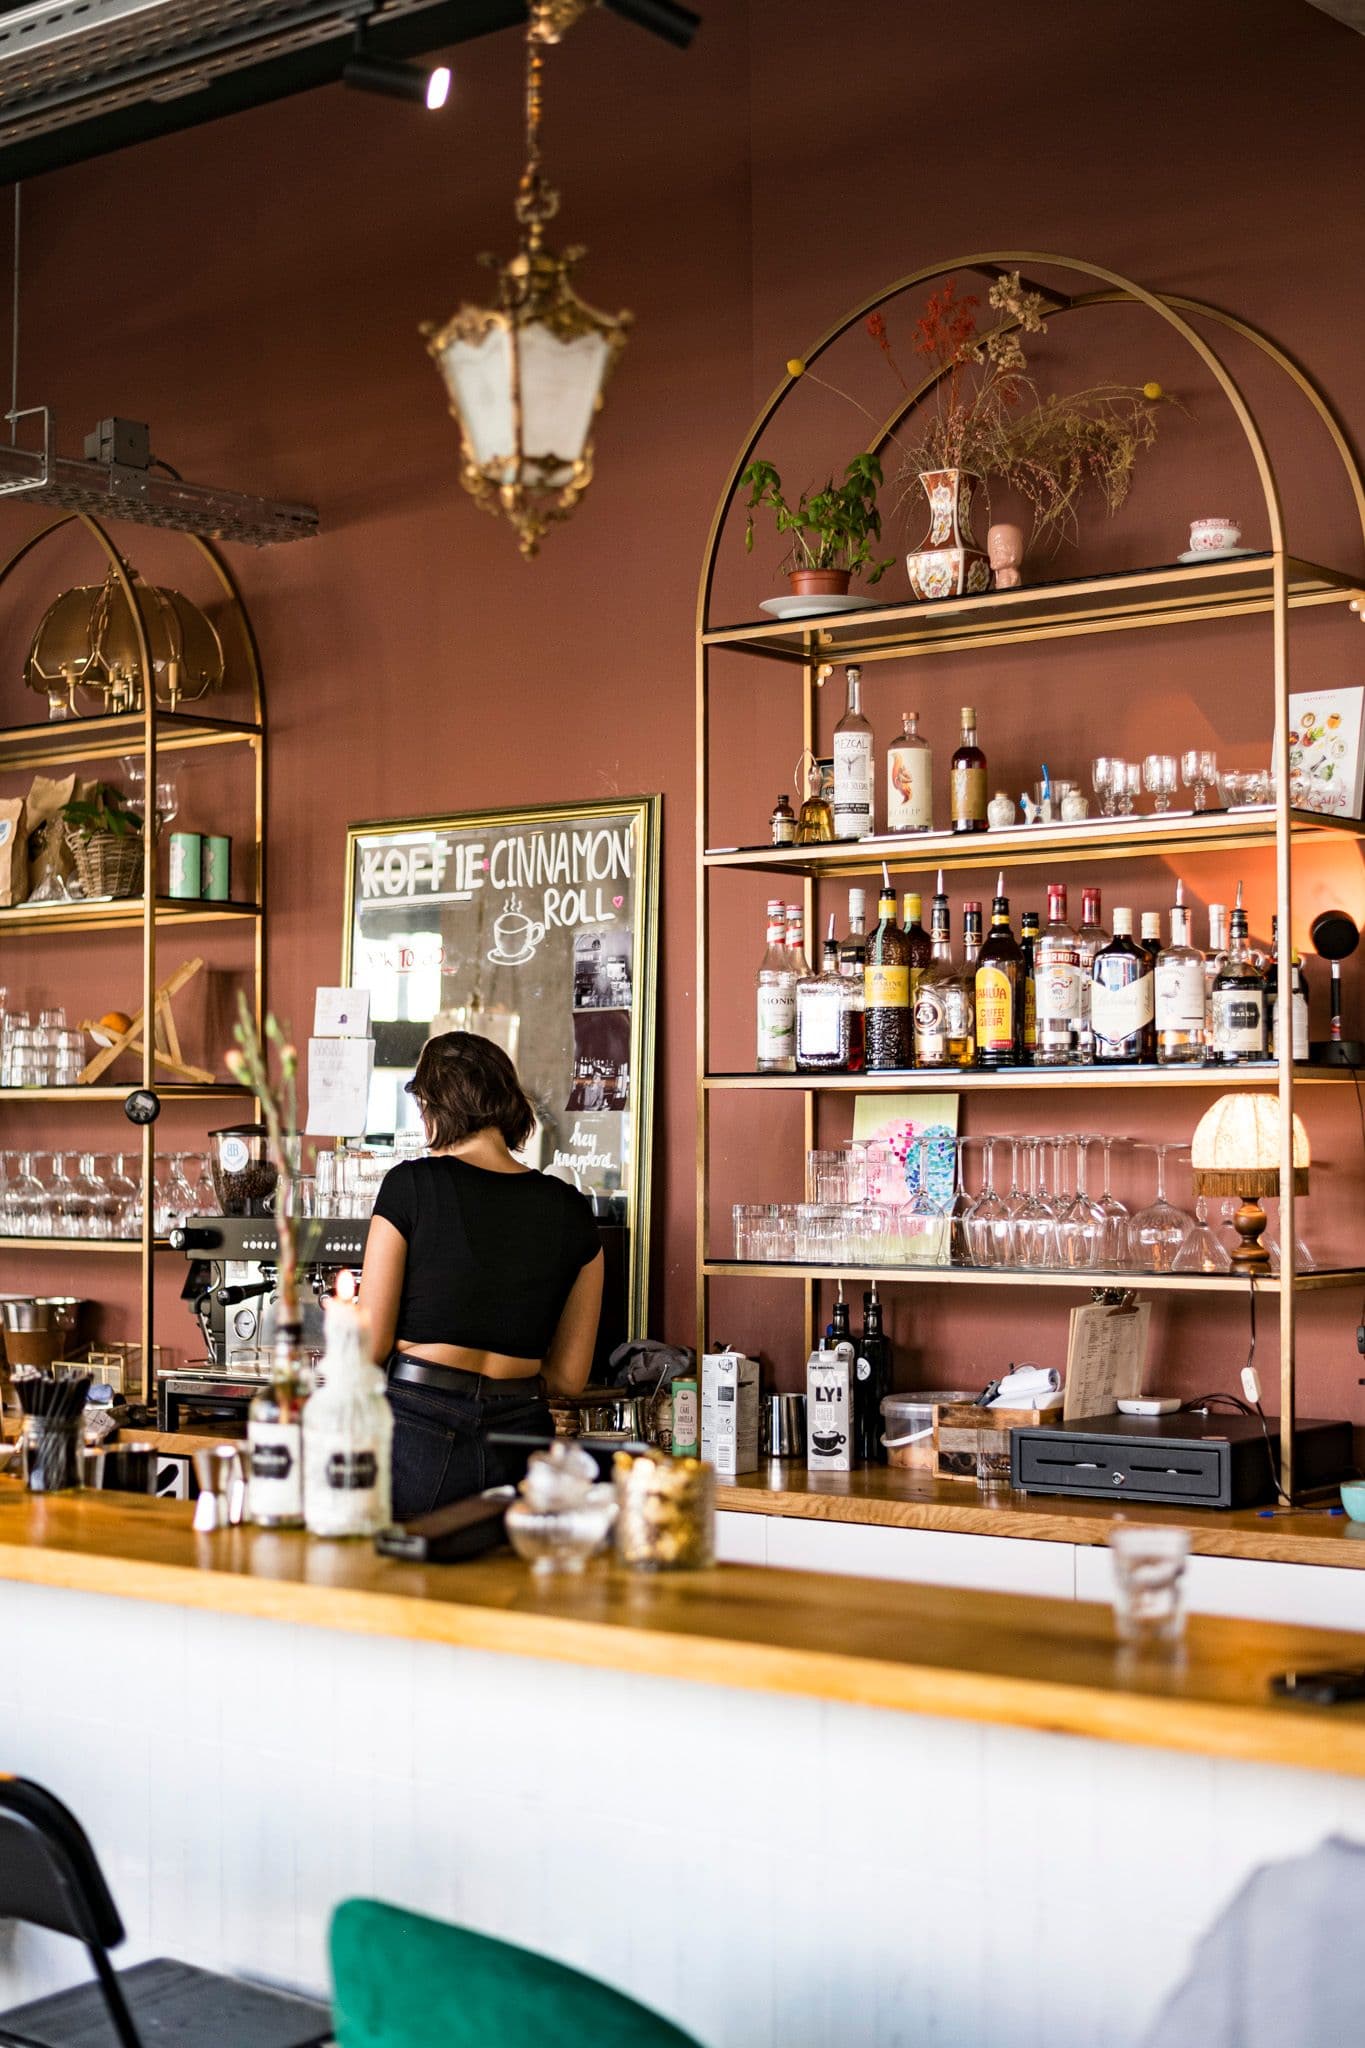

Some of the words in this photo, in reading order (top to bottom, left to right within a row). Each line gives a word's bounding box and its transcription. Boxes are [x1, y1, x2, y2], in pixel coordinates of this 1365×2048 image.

[361, 844, 484, 898] KOFFIE
[490, 829, 634, 890] CINNAMON
[544, 888, 615, 930] ROLL
[569, 1121, 597, 1156] hey
[815, 1386, 842, 1402] LY!
